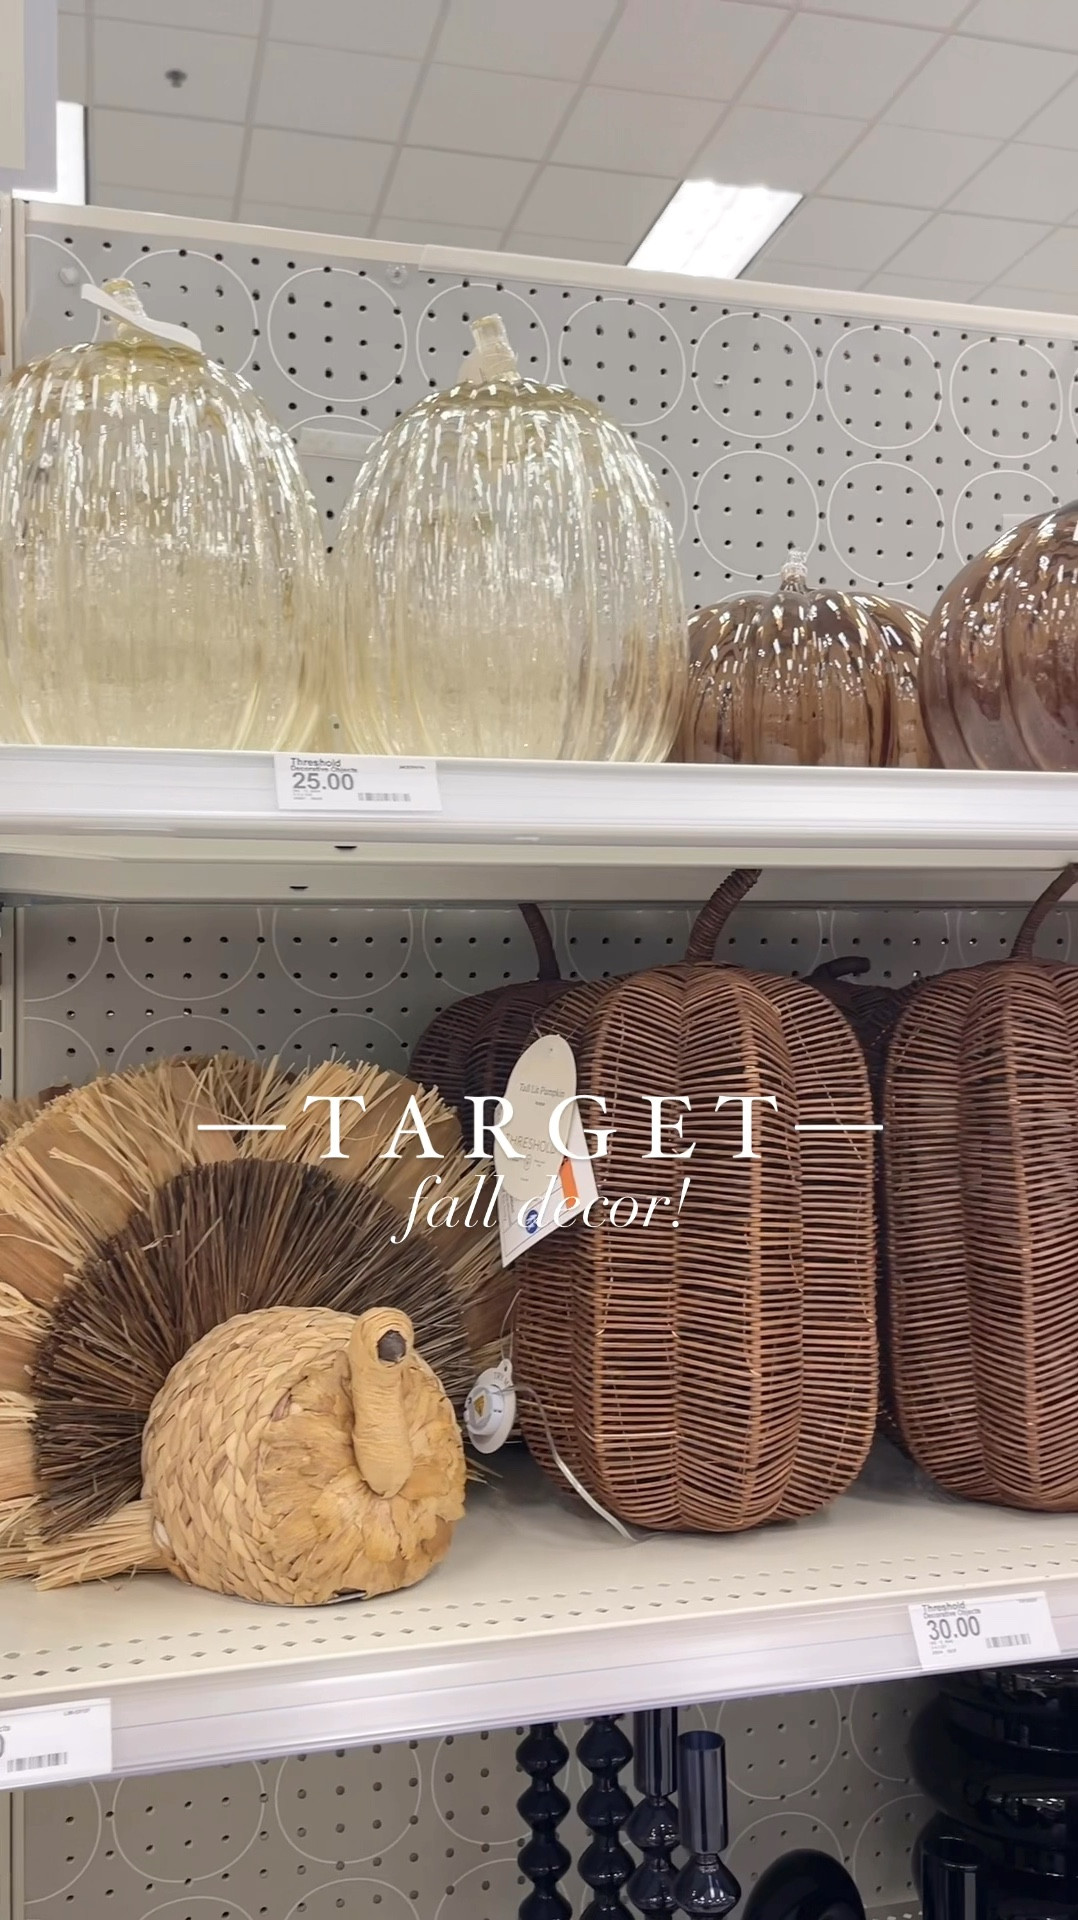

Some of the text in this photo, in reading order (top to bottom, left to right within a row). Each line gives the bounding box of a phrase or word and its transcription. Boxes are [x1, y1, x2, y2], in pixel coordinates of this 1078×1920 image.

[290, 757, 342, 767] Threshold
[292, 772, 354, 790] 25.00
[504, 1133, 557, 1154] HRESHOL
[921, 1601, 966, 1612] Threshold
[923, 1608, 981, 1619] Decorative Objects
[927, 1616, 980, 1640] 30.00
